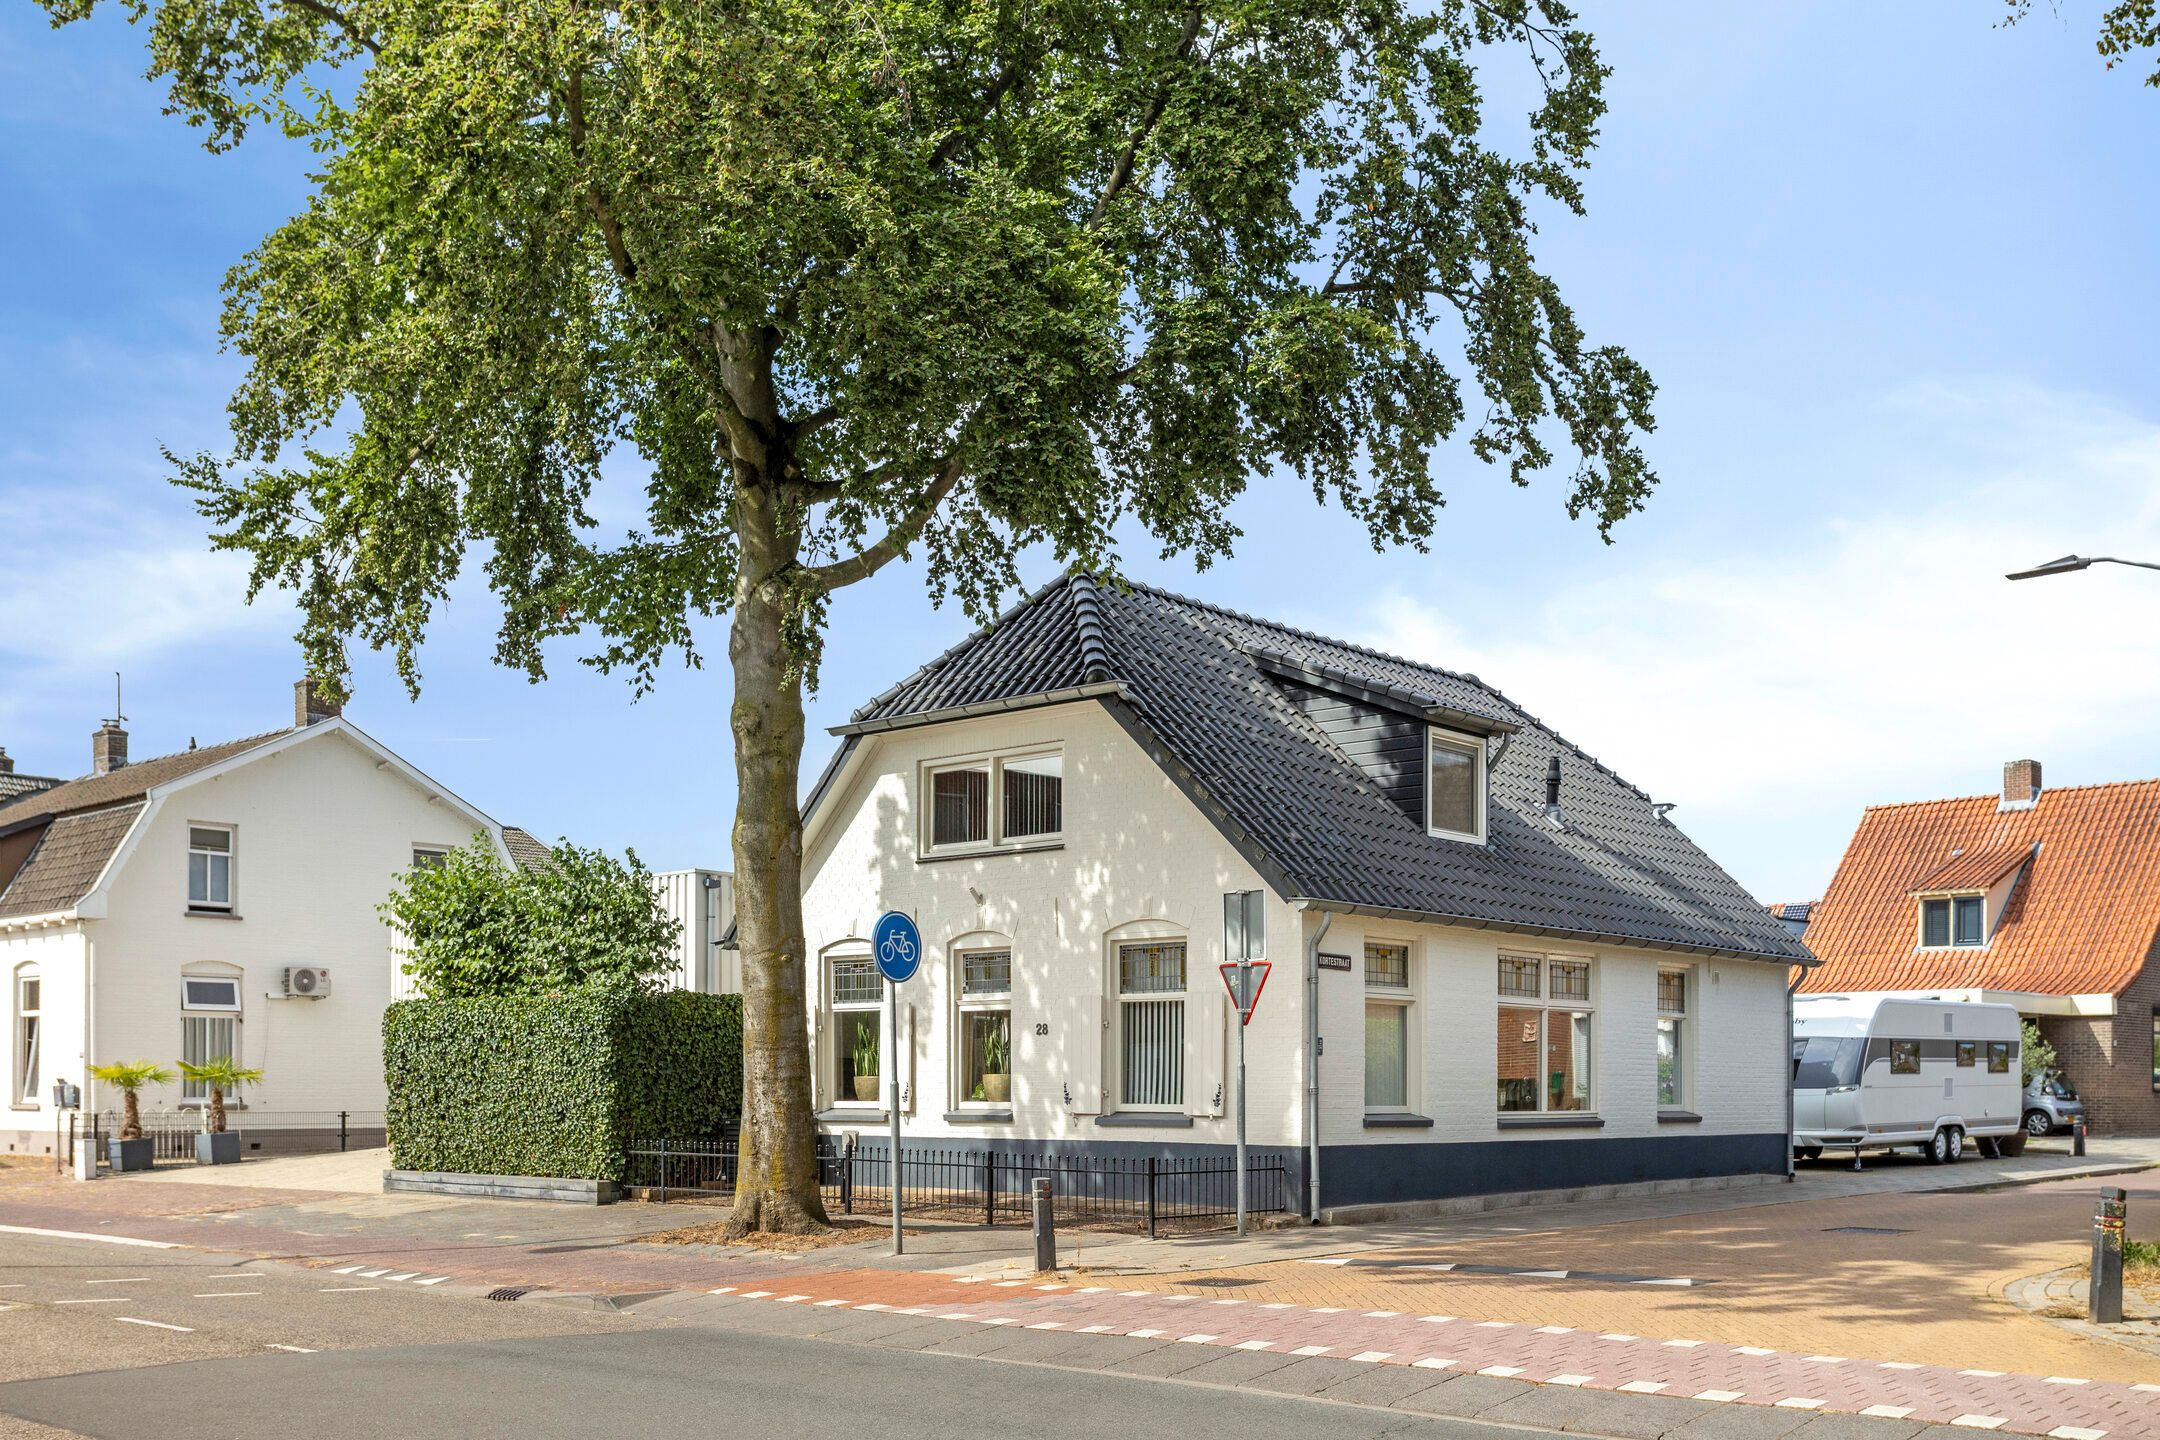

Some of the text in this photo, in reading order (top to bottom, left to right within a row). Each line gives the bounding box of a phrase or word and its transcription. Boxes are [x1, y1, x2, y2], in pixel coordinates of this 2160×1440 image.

[1319, 956, 1350, 967] KORTESTRAAT
[1793, 1018, 1807, 1026] by
[1036, 1023, 1048, 1035] 28
